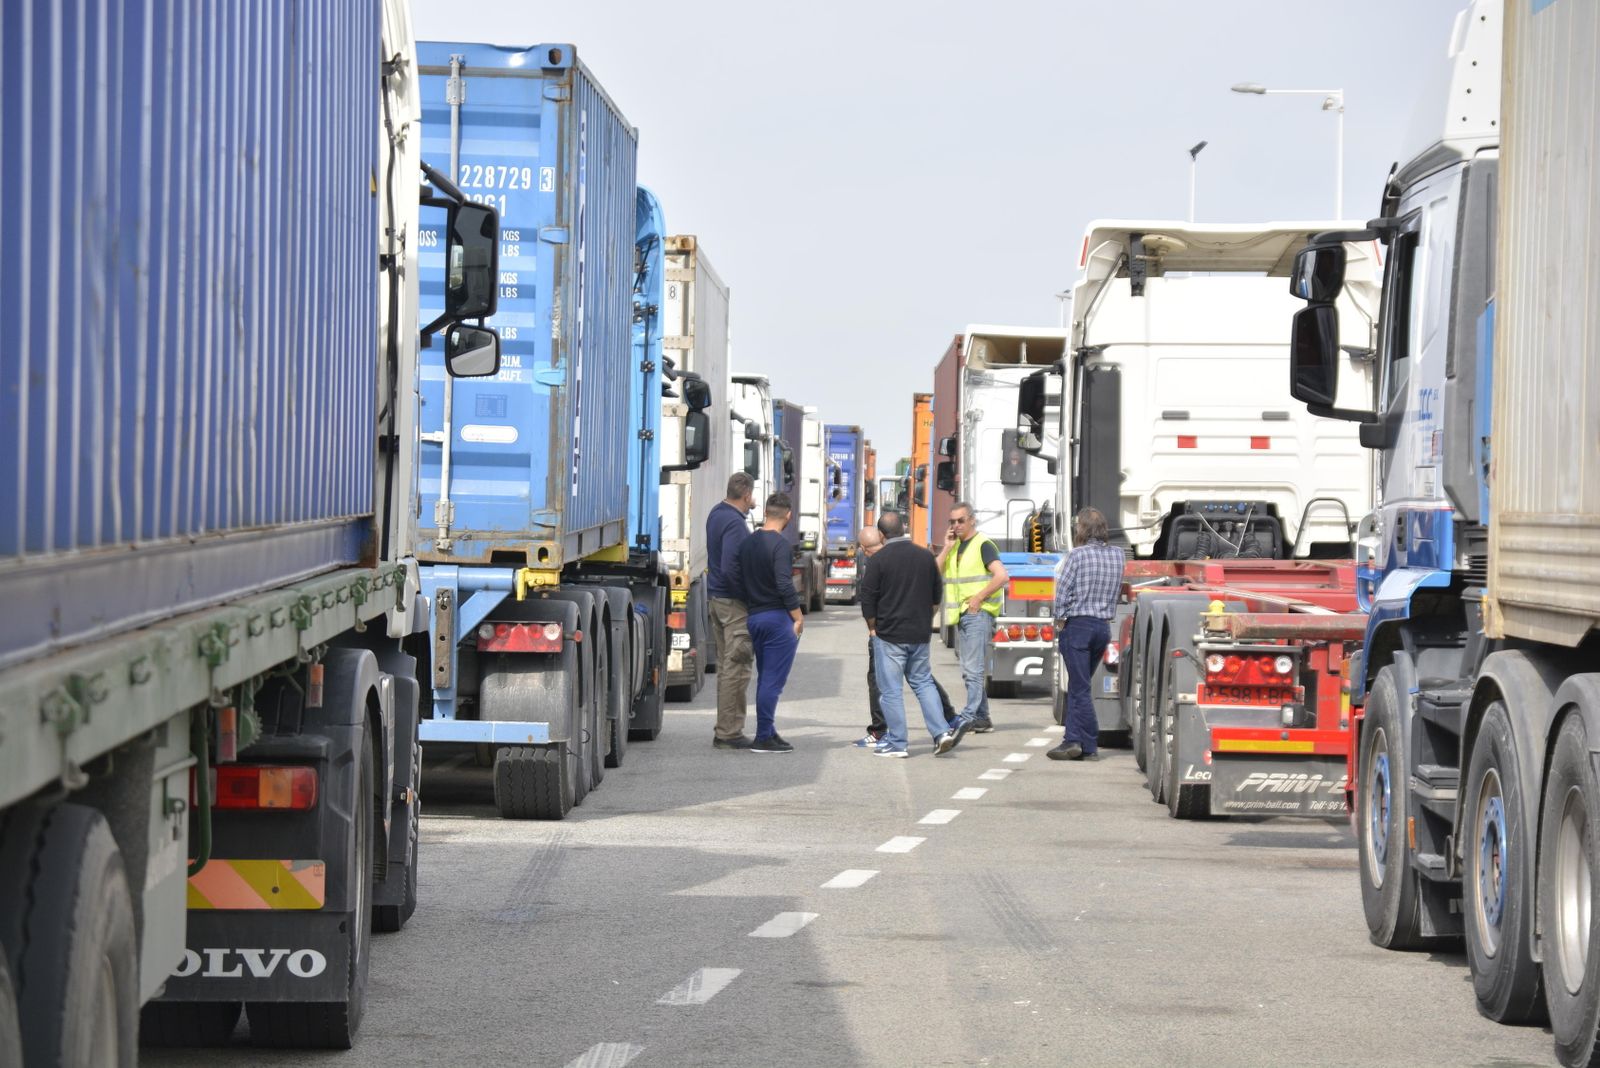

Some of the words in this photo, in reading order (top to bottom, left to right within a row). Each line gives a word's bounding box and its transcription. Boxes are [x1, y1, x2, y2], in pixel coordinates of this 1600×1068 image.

[460, 164, 532, 190] 228729
[541, 167, 553, 191] 3
[502, 230, 520, 242] KGS
[502, 244, 520, 257] LBS
[500, 272, 518, 285] KGS
[500, 287, 518, 298] LBS
[500, 327, 517, 339] LBS
